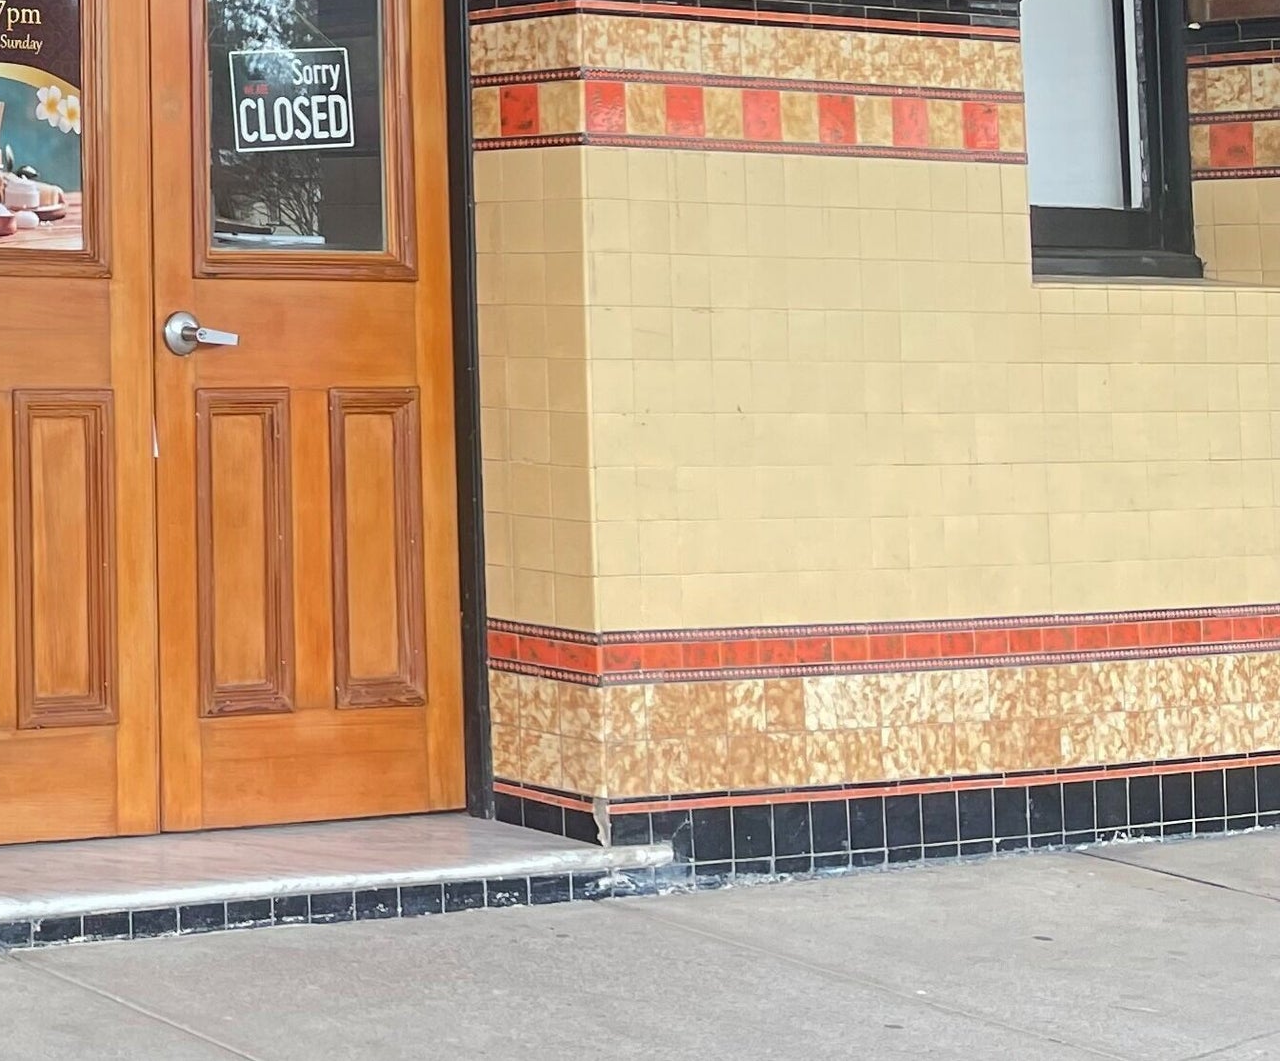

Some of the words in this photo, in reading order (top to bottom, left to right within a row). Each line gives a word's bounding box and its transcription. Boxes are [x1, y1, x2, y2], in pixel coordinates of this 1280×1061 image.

[0, 33, 43, 55] Sunday
[291, 58, 340, 91] Sorry
[239, 94, 348, 143] CLOSED
